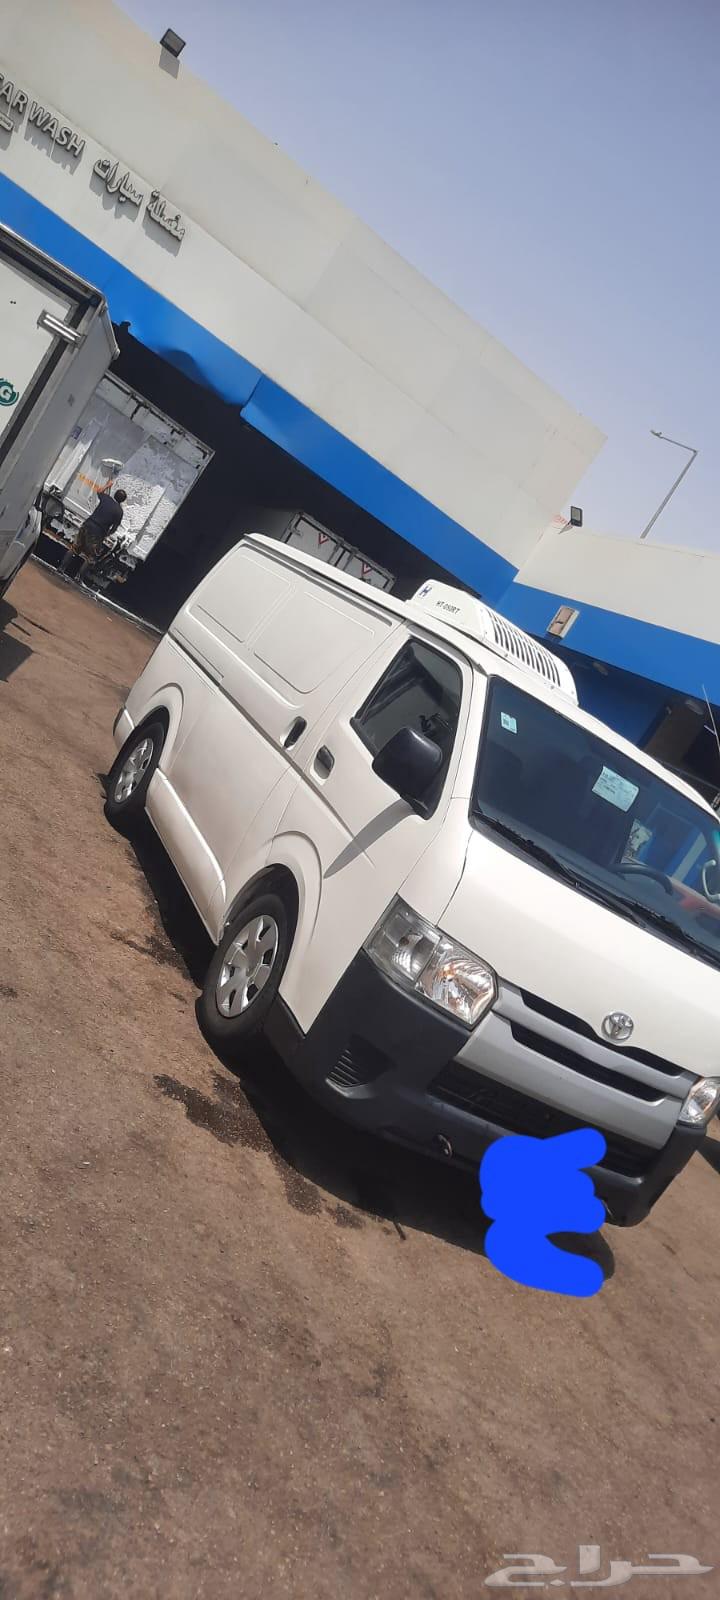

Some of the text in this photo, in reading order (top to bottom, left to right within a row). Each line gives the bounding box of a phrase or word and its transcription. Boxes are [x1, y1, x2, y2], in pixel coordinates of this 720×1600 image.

[0, 73, 29, 113] AR
[28, 101, 86, 158] WASH
[92, 159, 186, 241] مغسلة سيارات
